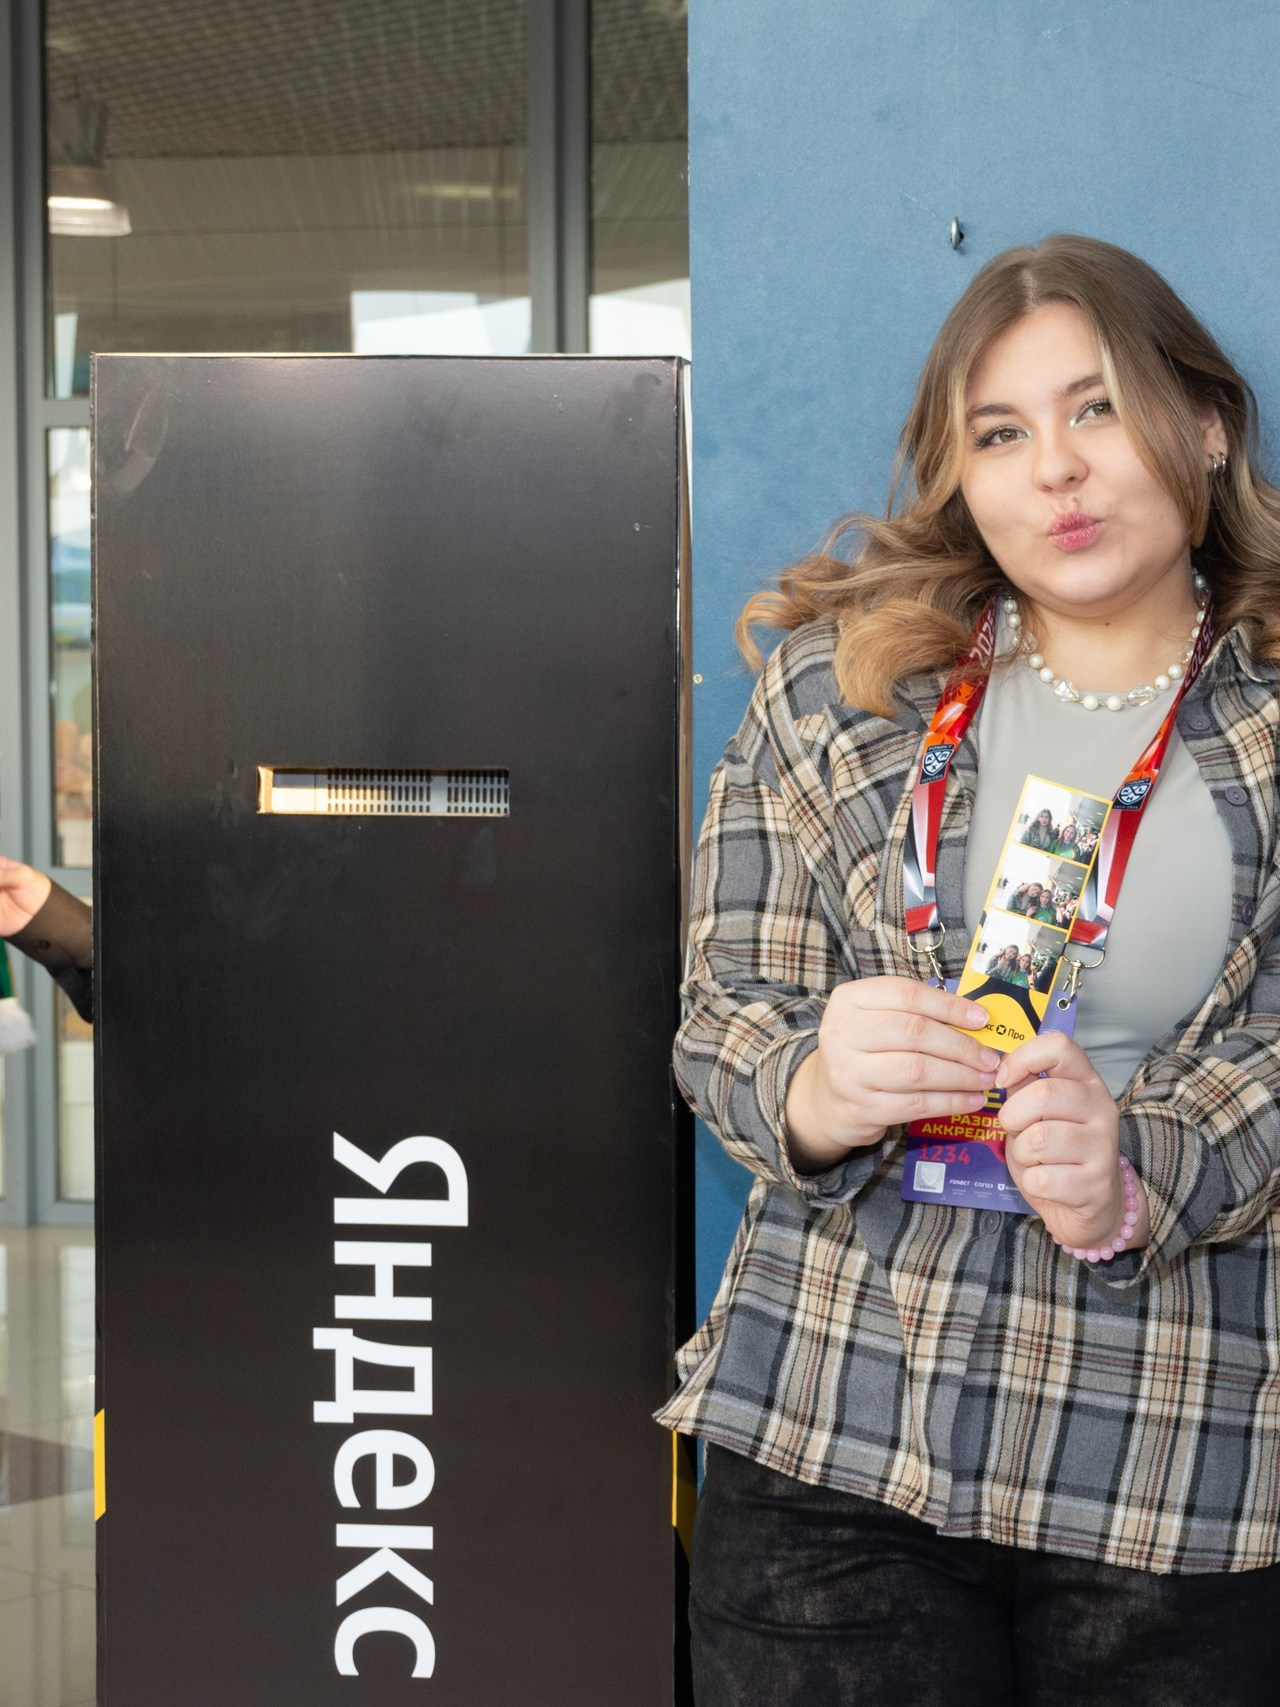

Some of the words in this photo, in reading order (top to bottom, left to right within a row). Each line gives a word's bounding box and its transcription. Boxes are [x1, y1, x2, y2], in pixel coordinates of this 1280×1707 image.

[1007, 1028, 1025, 1041] Про
[918, 1143, 970, 1165] 1234
[313, 1131, 469, 1679] Яндекс
